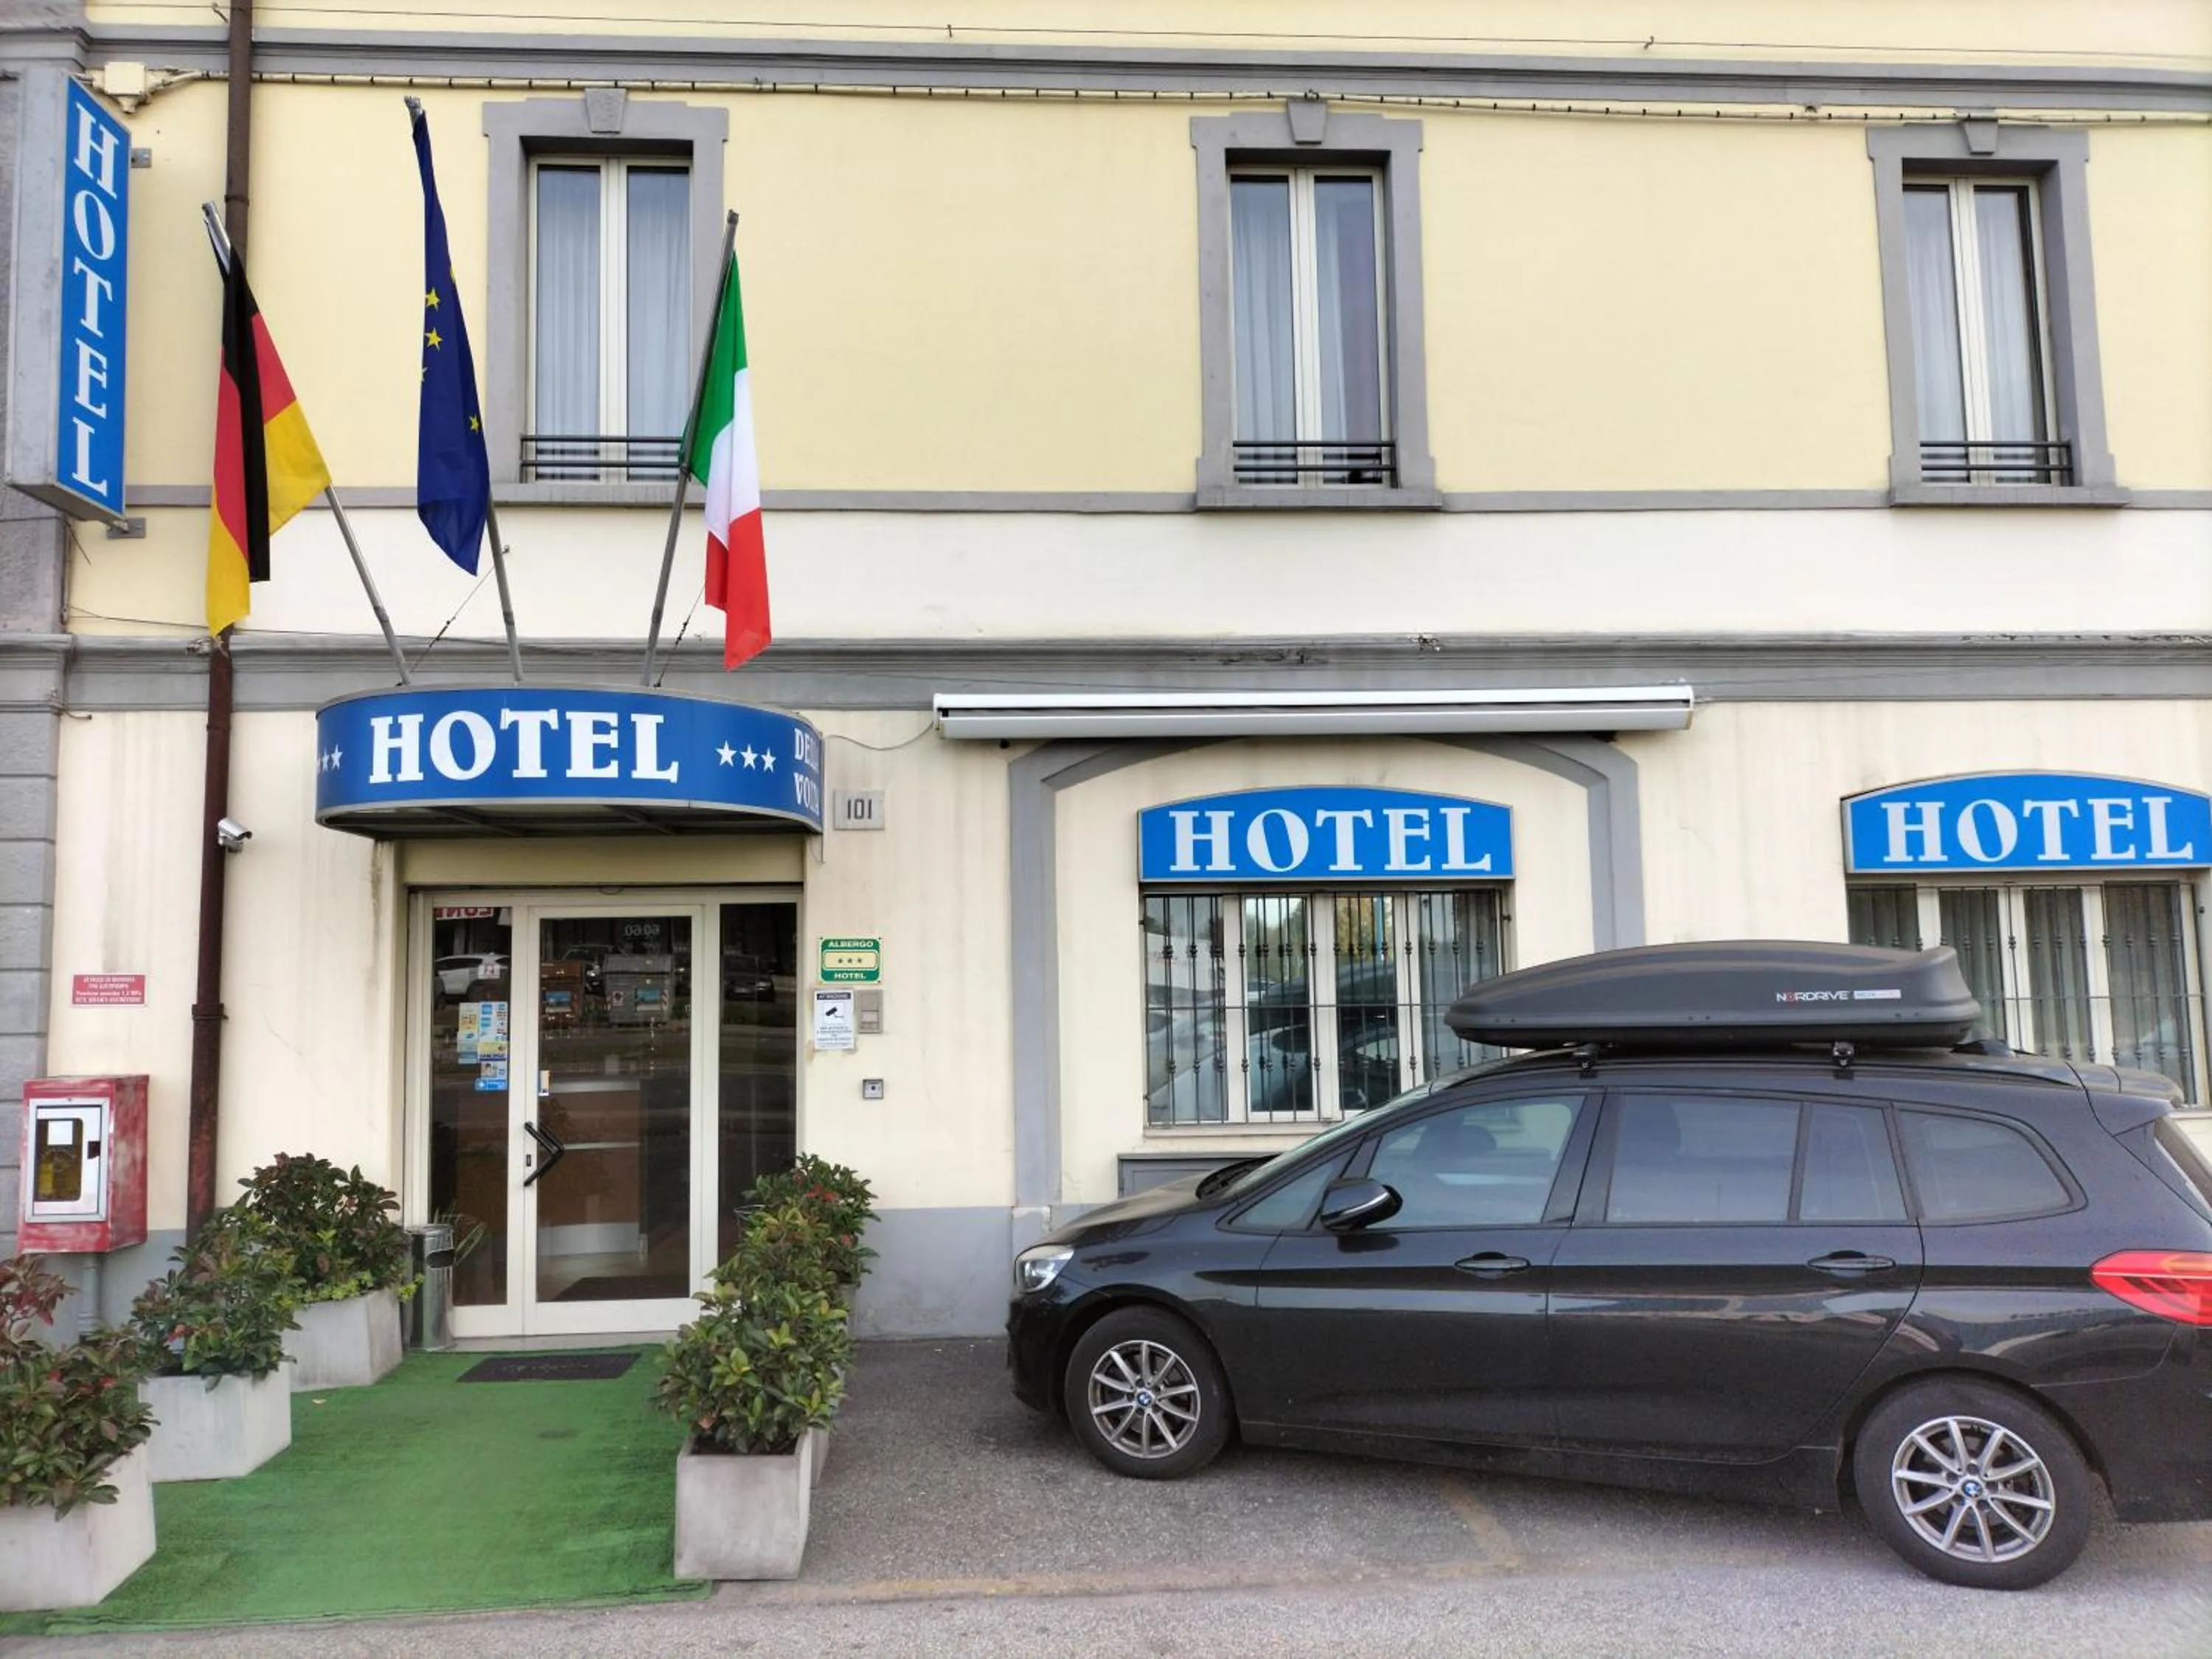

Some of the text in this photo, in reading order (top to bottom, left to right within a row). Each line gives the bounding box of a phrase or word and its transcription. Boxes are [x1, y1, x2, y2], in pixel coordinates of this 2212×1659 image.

[72, 102, 119, 496] HOTEL
[368, 708, 679, 785] HOTEL
[847, 799, 872, 820] 101
[1169, 807, 1492, 872] HOTEL
[1880, 796, 2194, 863] HOTEL
[1776, 990, 1848, 1001] NORDRIVE
